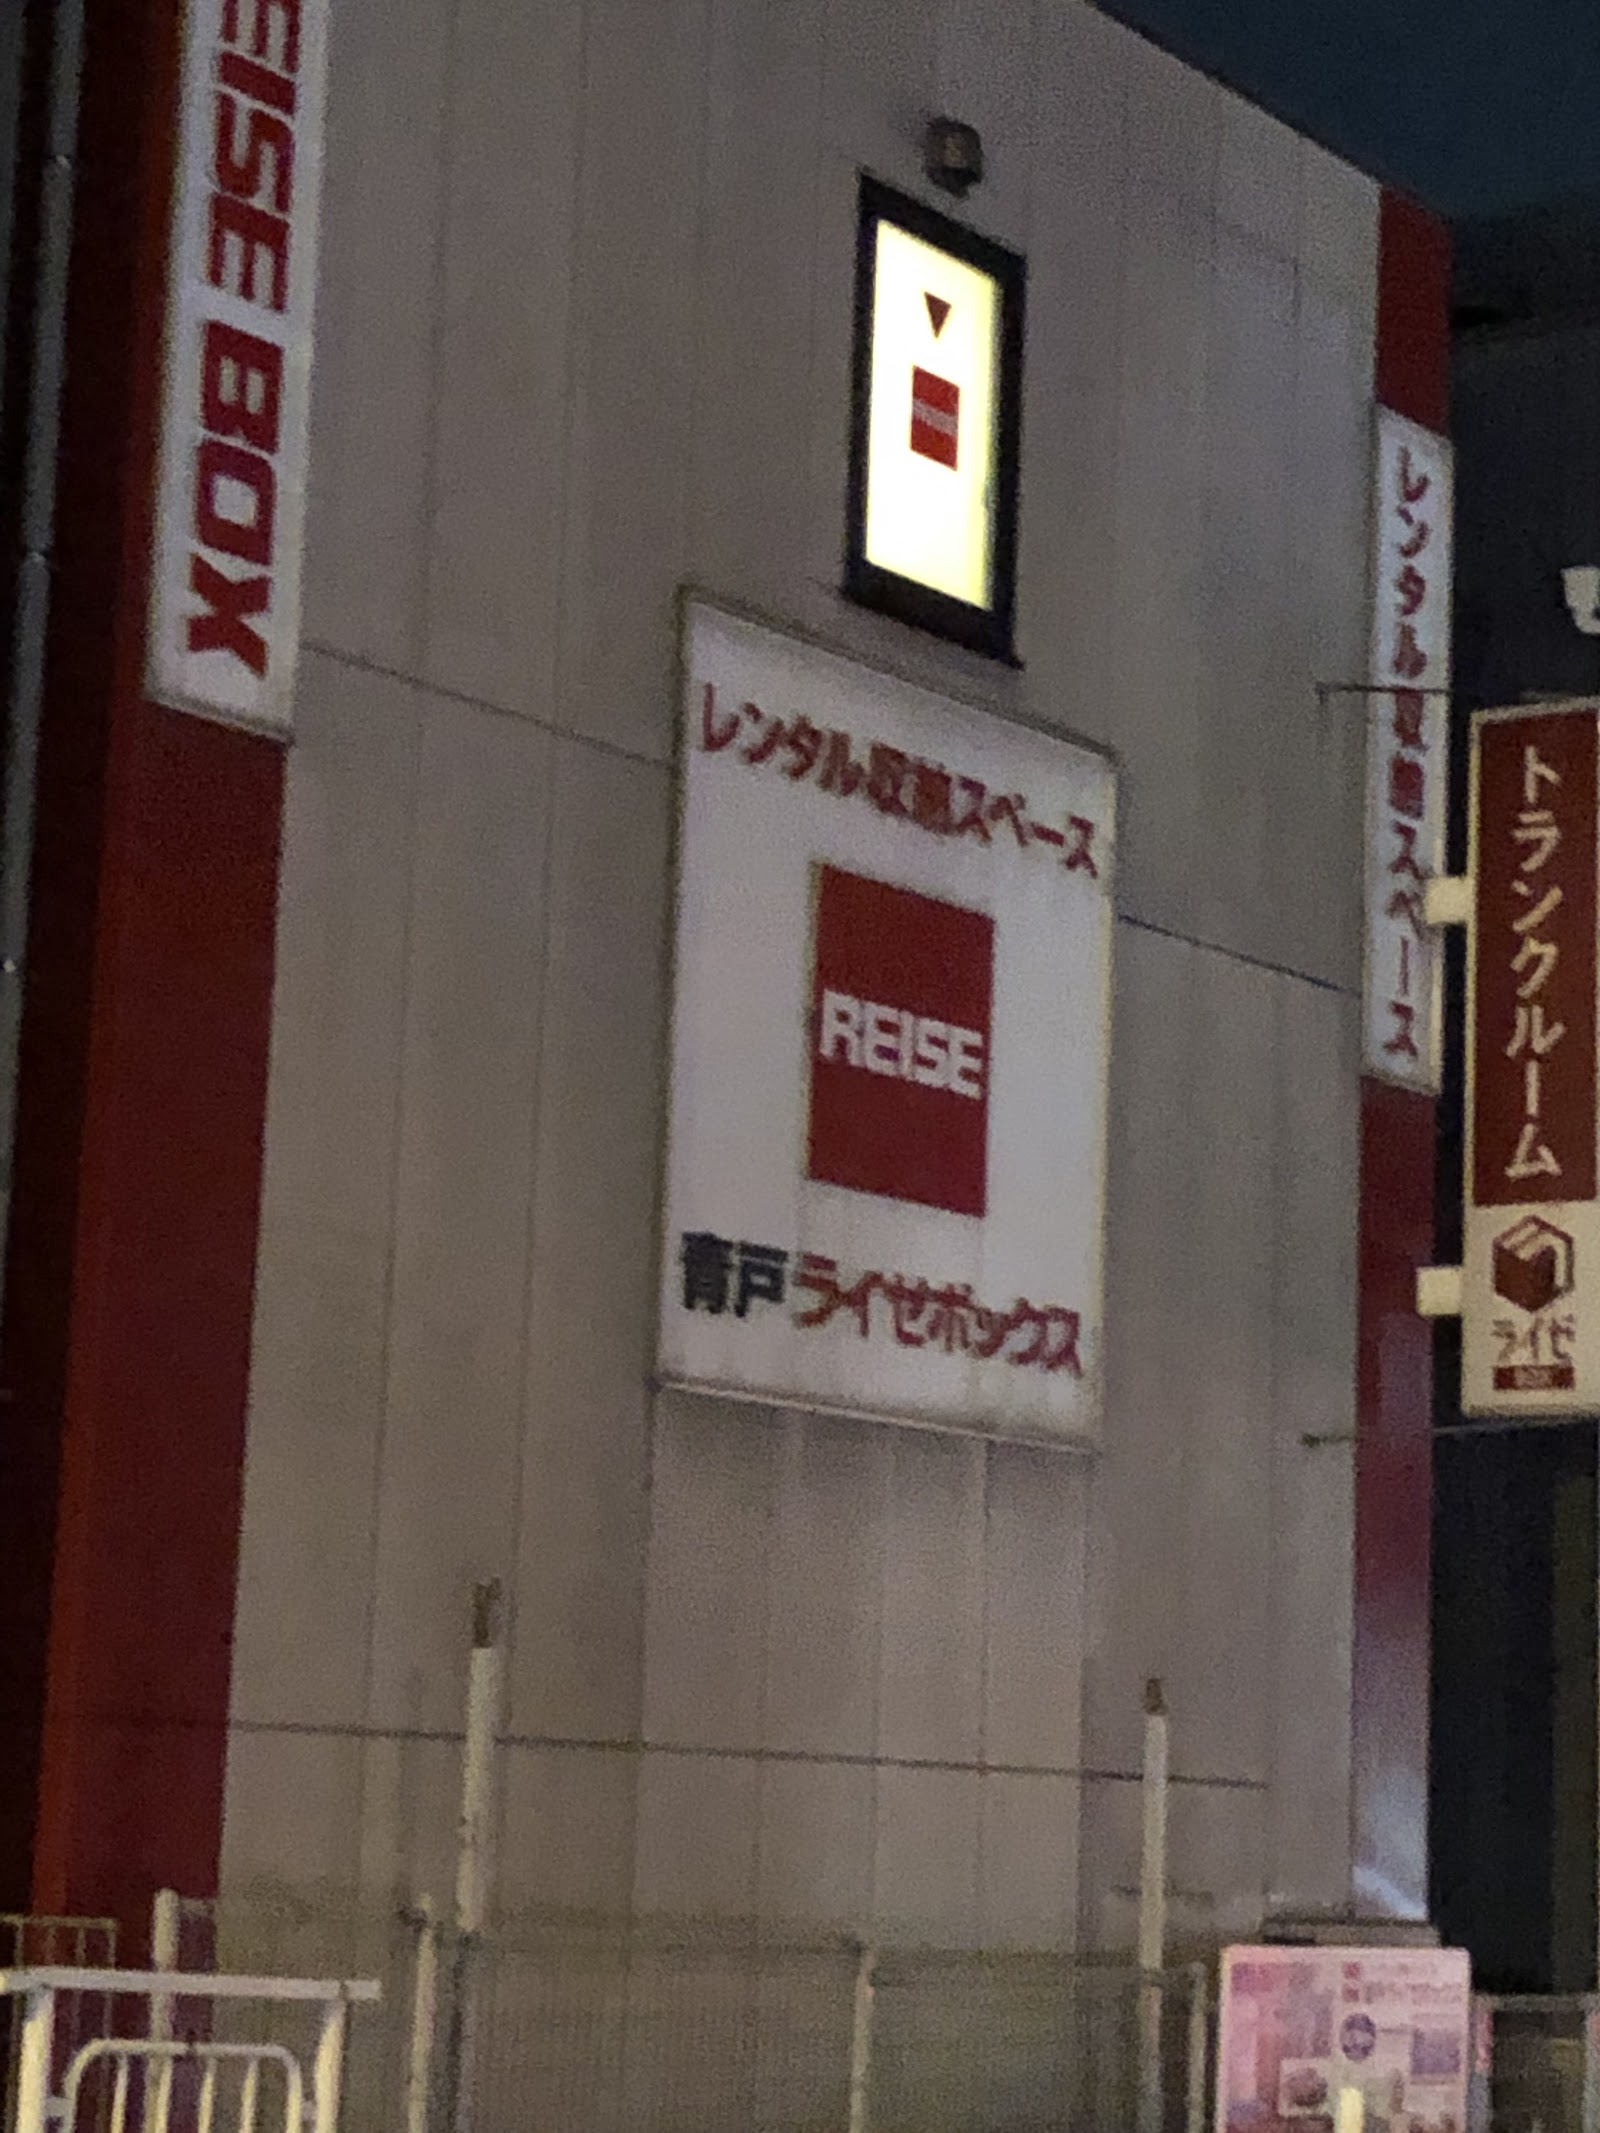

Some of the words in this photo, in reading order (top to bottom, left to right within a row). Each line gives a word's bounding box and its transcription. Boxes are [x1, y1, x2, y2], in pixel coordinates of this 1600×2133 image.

[187, 319, 284, 681] BOX
[1386, 445, 1430, 1058] レンタルスペース
[819, 987, 984, 1101] REISE
[1505, 744, 1565, 1180] トランクルーム
